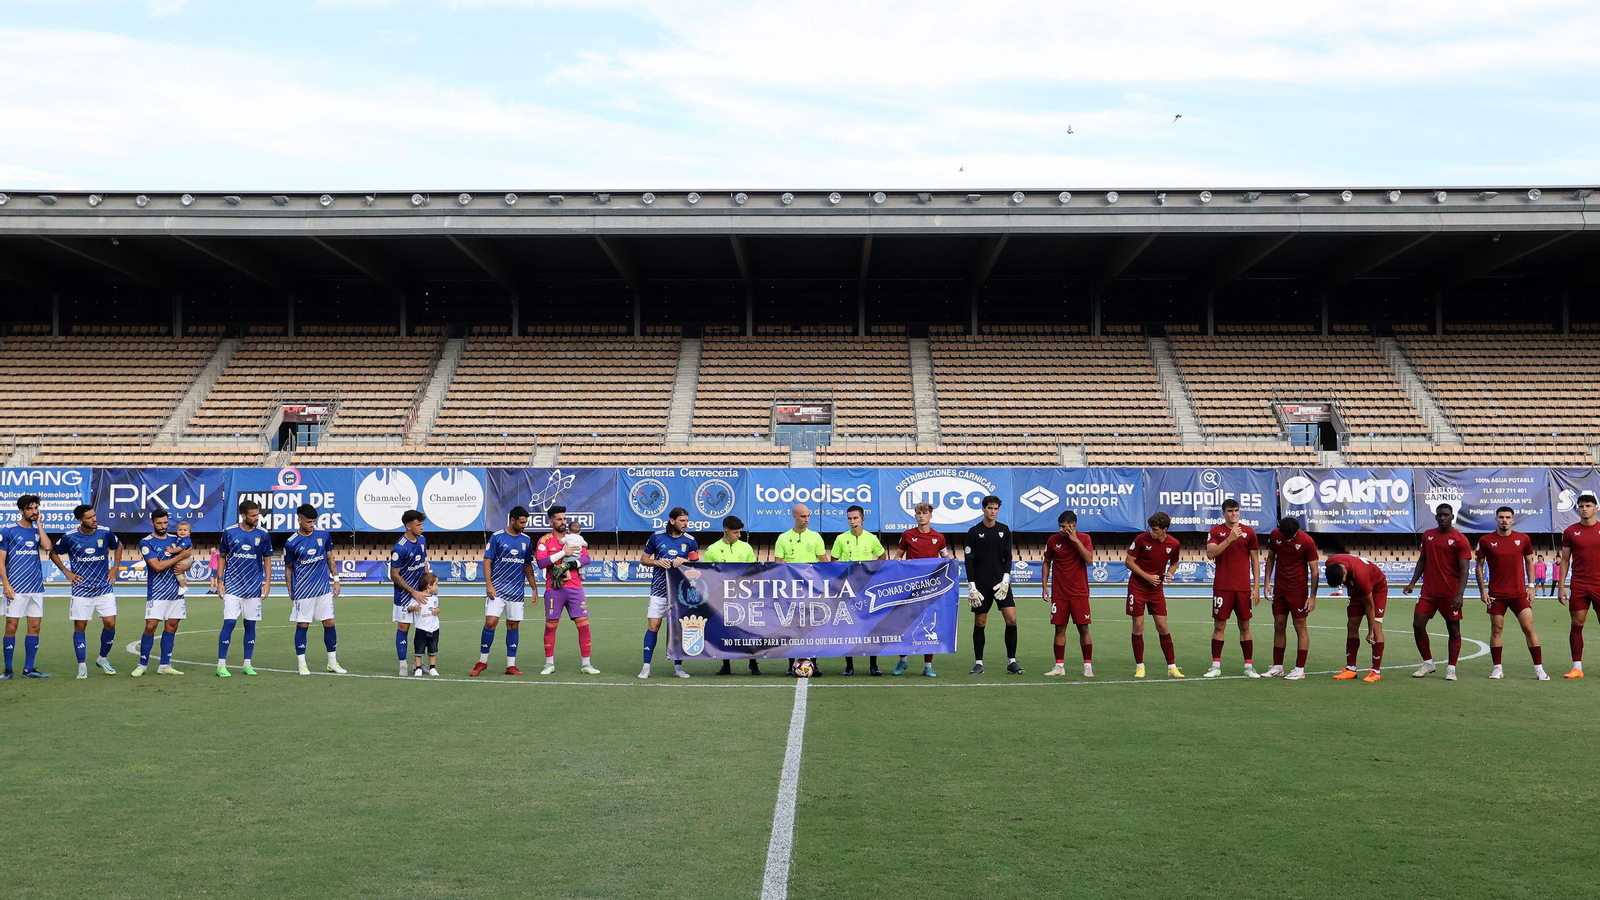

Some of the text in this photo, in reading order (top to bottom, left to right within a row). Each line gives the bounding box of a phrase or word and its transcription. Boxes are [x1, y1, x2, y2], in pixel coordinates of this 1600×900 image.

[627, 468, 738, 478] Cafetería Cervecería
[895, 469, 996, 493] DISTRIBUCIONES CÁRNICAS
[1066, 483, 1135, 496] OCIOPLAY
[38, 491, 82, 499] Homologada
[109, 484, 204, 509] PKW
[364, 494, 411, 502] Chamaeleo
[430, 494, 476, 502] Chamaeleo
[1425, 493, 1462, 501] GARRIDO
[310, 493, 335, 509] DE
[906, 491, 987, 510] LUGO
[1066, 497, 1119, 507] INDOOR
[5, 513, 22, 521] 789
[46, 513, 63, 521] 395
[64, 513, 78, 521] 67
[1067, 508, 1102, 516] EREZ
[1285, 508, 1409, 517] Hogar Menaje Textil Droguería
[1470, 508, 1495, 516] Polígono
[119, 570, 148, 579] CARL
[723, 579, 857, 599] ESTRELLA
[877, 577, 942, 598] DONAR ÓRGANOS
[1129, 594, 1134, 605] 3
[1213, 596, 1223, 608] 19
[723, 601, 854, 627] DE VIDA
[734, 638, 742, 646] TE
[742, 638, 763, 646] LLEVES
[763, 638, 779, 646] PARA
[781, 638, 788, 646] EL
[788, 638, 805, 646] CIELO
[815, 638, 827, 646] QUE
[828, 637, 843, 645] HACE
[844, 637, 862, 645] FALTA
[864, 636, 871, 644] EN
[873, 636, 881, 644] LA
